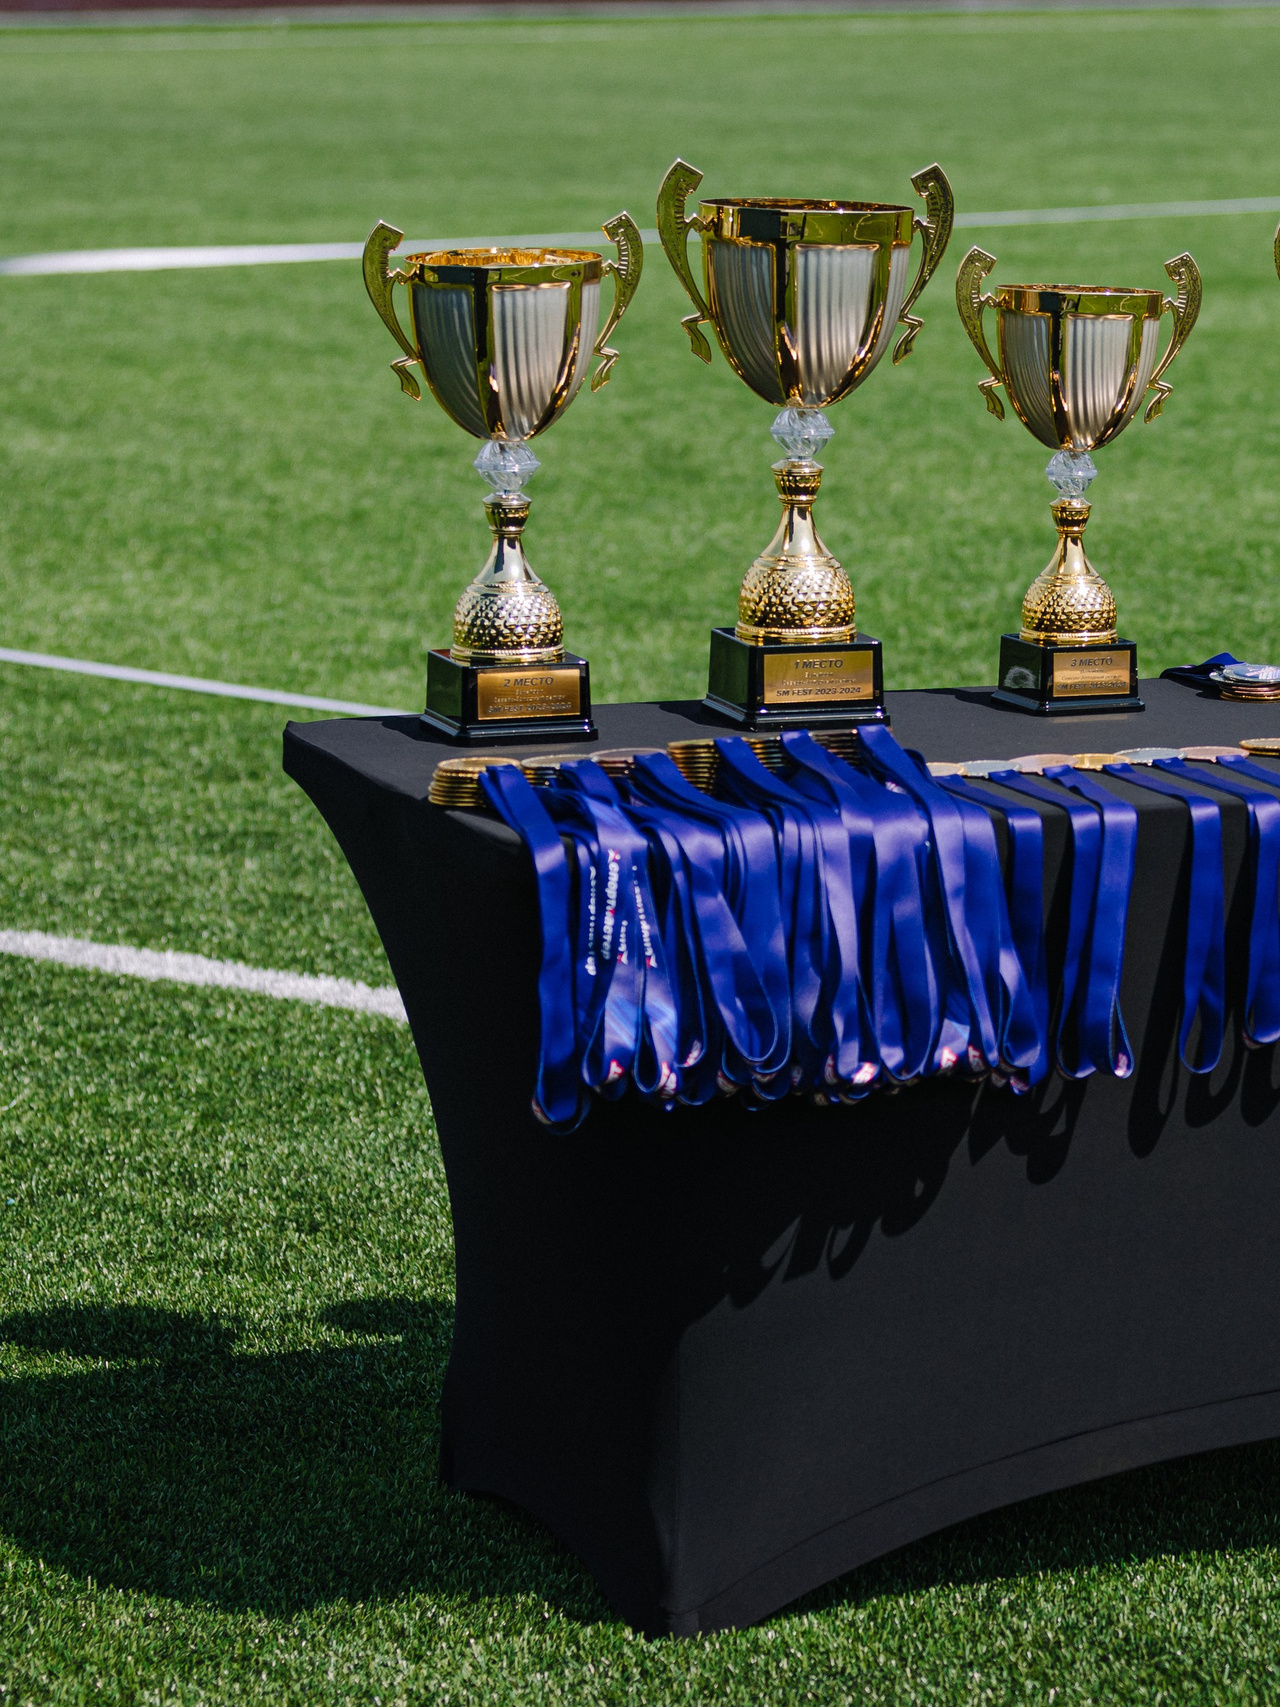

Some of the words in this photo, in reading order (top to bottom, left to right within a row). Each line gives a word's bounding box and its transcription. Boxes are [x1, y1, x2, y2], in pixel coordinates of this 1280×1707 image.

[794, 659, 800, 669] 1
[802, 659, 844, 669] МЕСТО
[1070, 658, 1077, 667] 3
[1078, 656, 1113, 667] МЕСТО
[503, 679, 511, 687] 2
[513, 676, 554, 687] МЕСТО
[1069, 682, 1086, 690] FEST
[776, 689, 789, 697] SM
[792, 688, 813, 696] FEST
[815, 687, 862, 695] 2023-2024
[488, 705, 501, 713] SM
[503, 704, 524, 712] FEST
